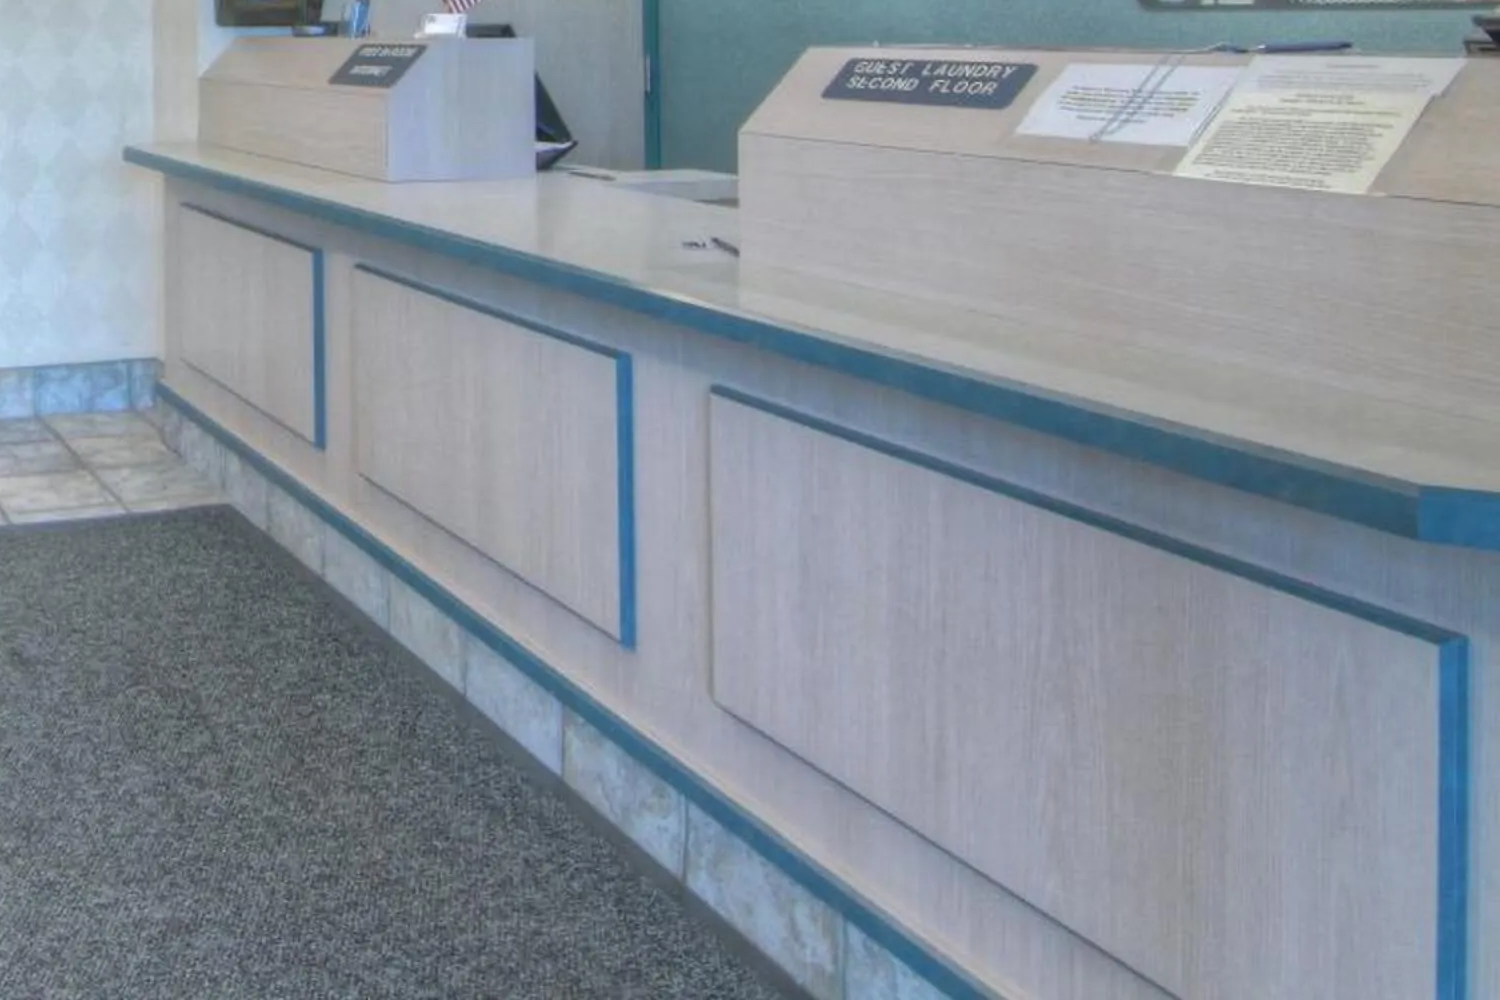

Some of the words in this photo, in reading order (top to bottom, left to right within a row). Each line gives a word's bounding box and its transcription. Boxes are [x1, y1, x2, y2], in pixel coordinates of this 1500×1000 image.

[854, 61, 914, 75] GUEST
[921, 62, 1018, 79] LAUNDRY
[846, 76, 919, 91] SECOND
[928, 79, 998, 95] FLOOR
